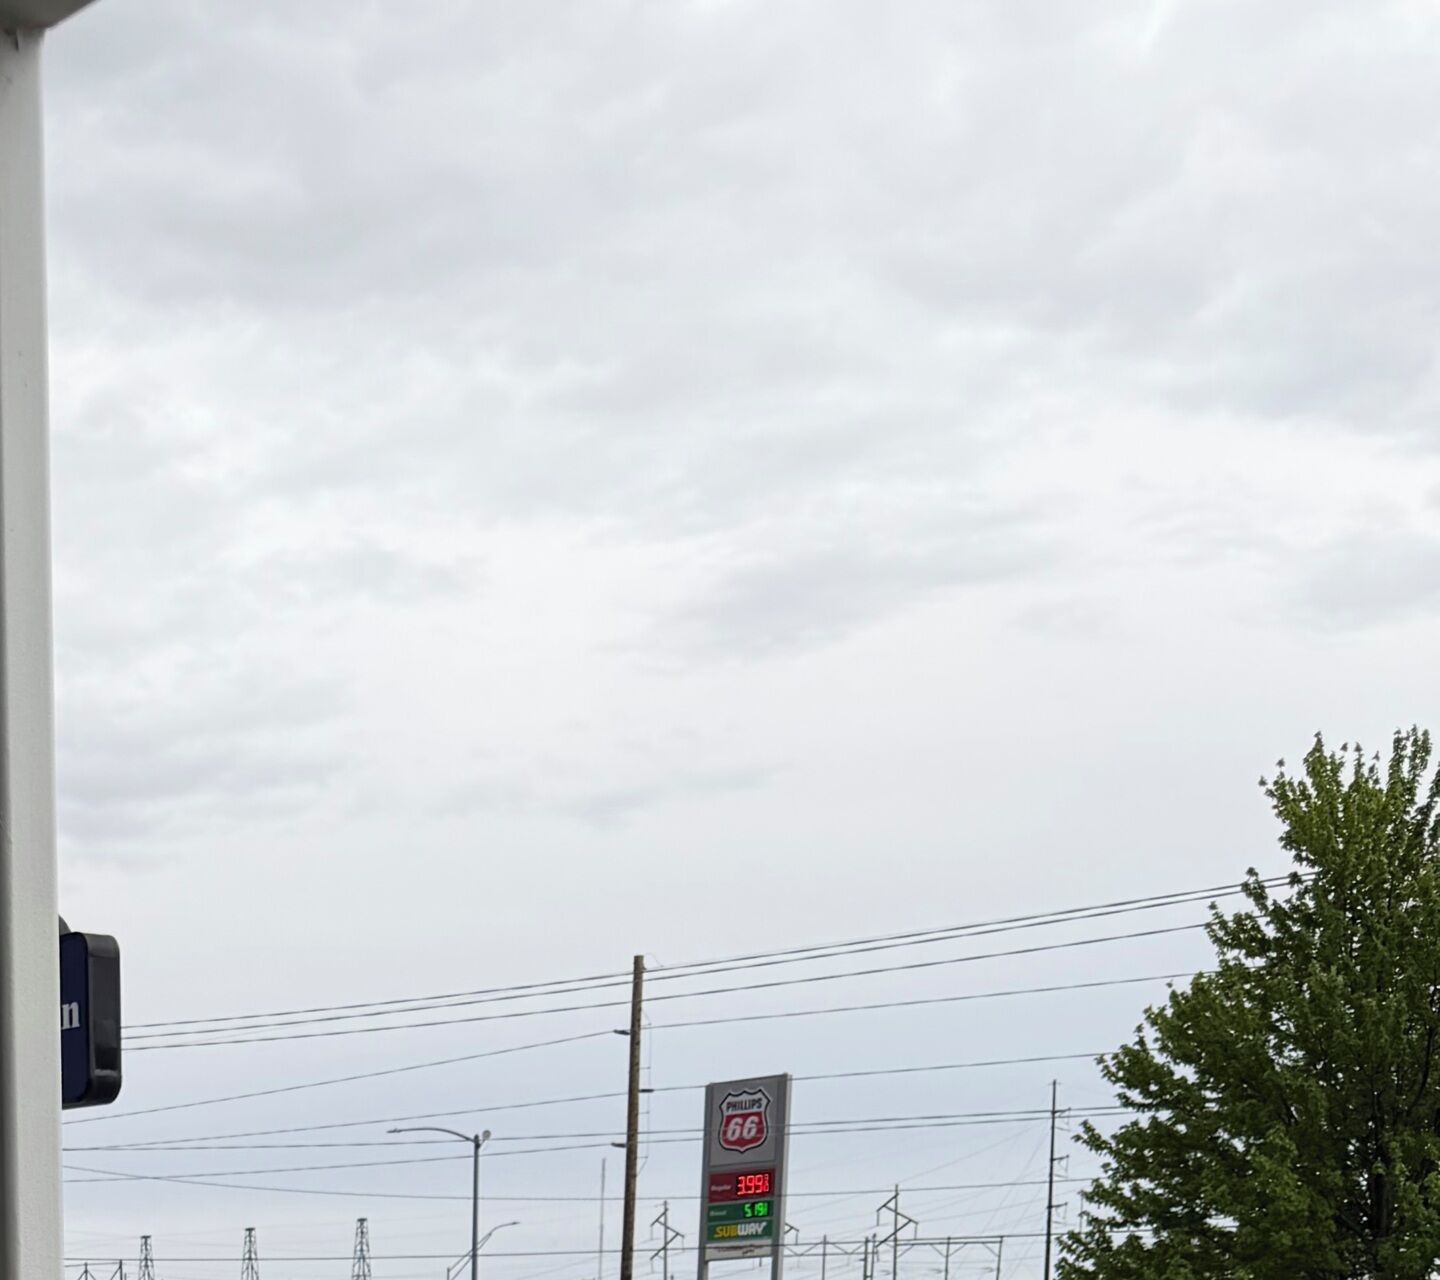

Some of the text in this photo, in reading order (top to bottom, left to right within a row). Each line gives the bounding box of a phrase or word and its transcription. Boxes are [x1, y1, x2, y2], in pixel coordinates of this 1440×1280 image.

[726, 1097, 763, 1113] PHILLIPS
[726, 1115, 760, 1141] 66
[714, 1221, 768, 1239] SUBWAY
